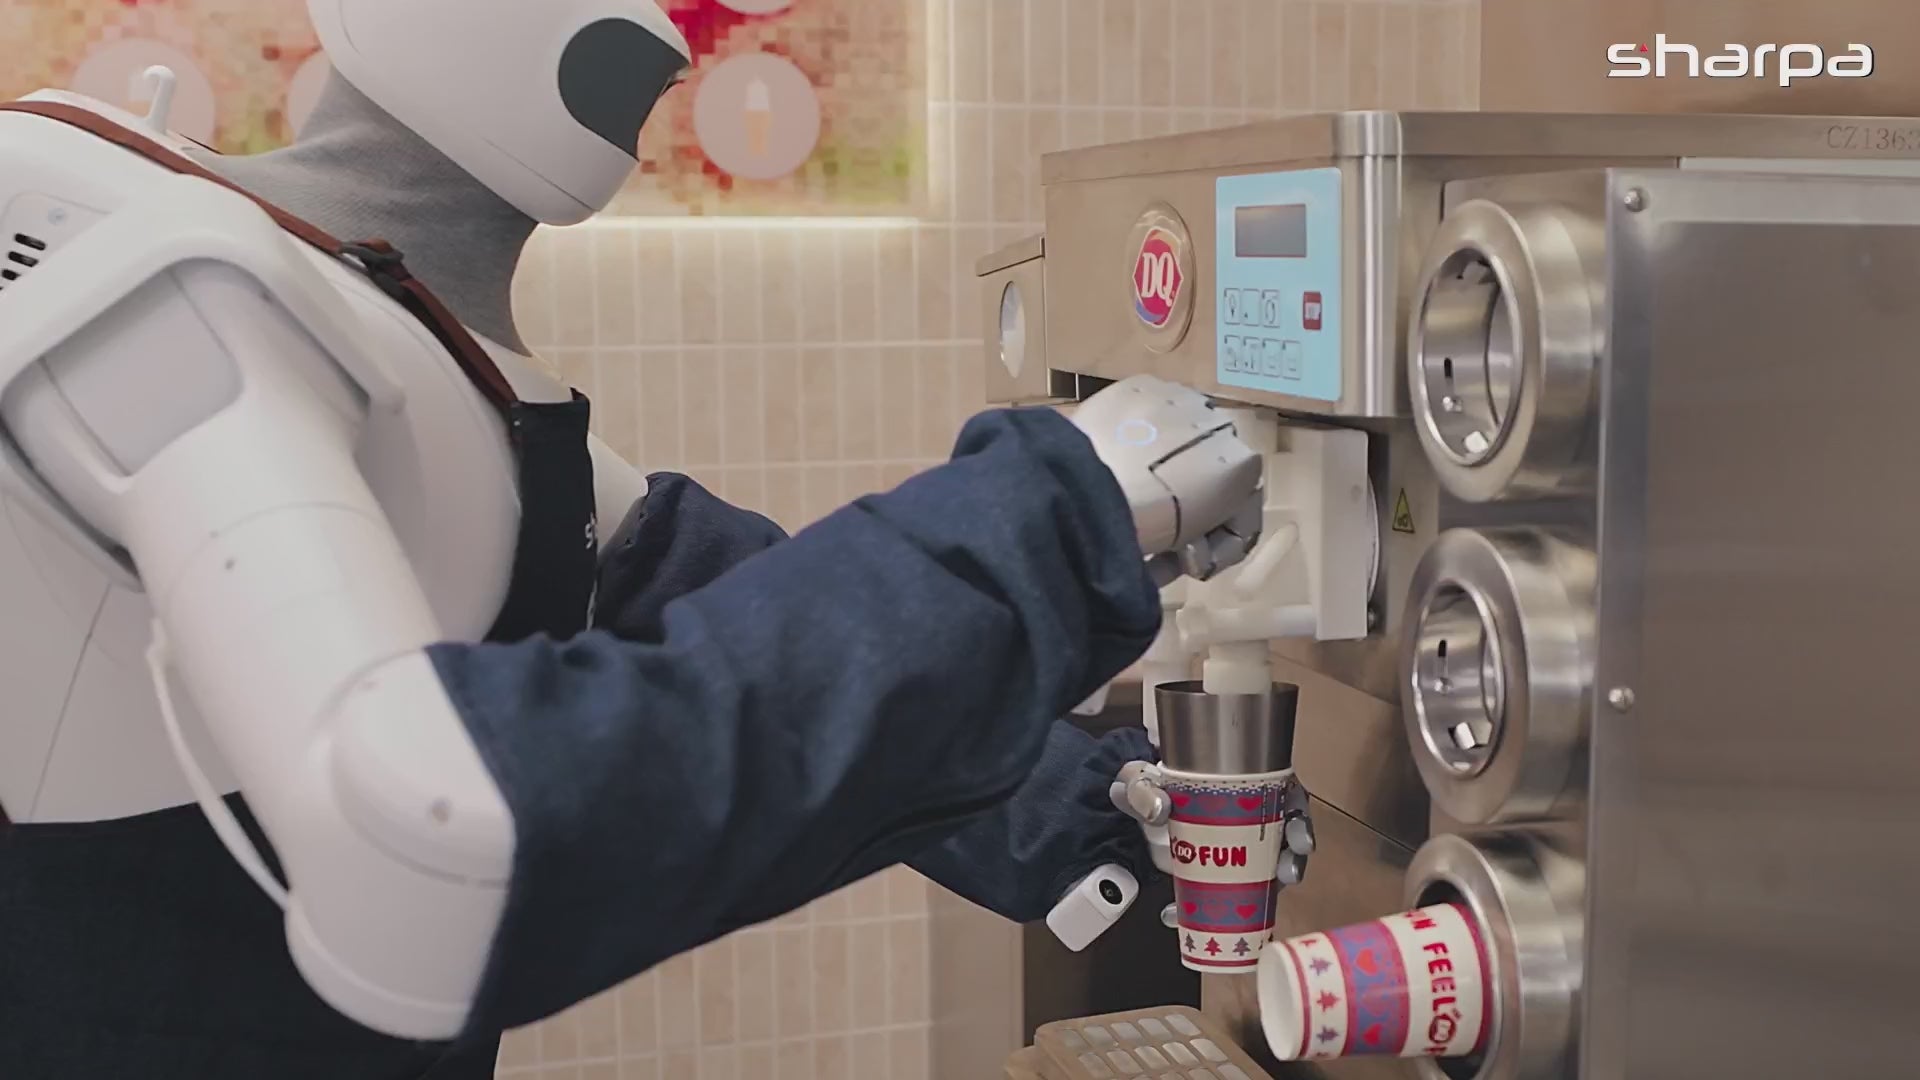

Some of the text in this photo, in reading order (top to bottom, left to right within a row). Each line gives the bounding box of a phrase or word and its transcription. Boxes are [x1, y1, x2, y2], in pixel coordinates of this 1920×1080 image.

[1141, 251, 1174, 307] DQ
[1198, 845, 1247, 867] FUN
[1423, 942, 1457, 1012] FEEL
